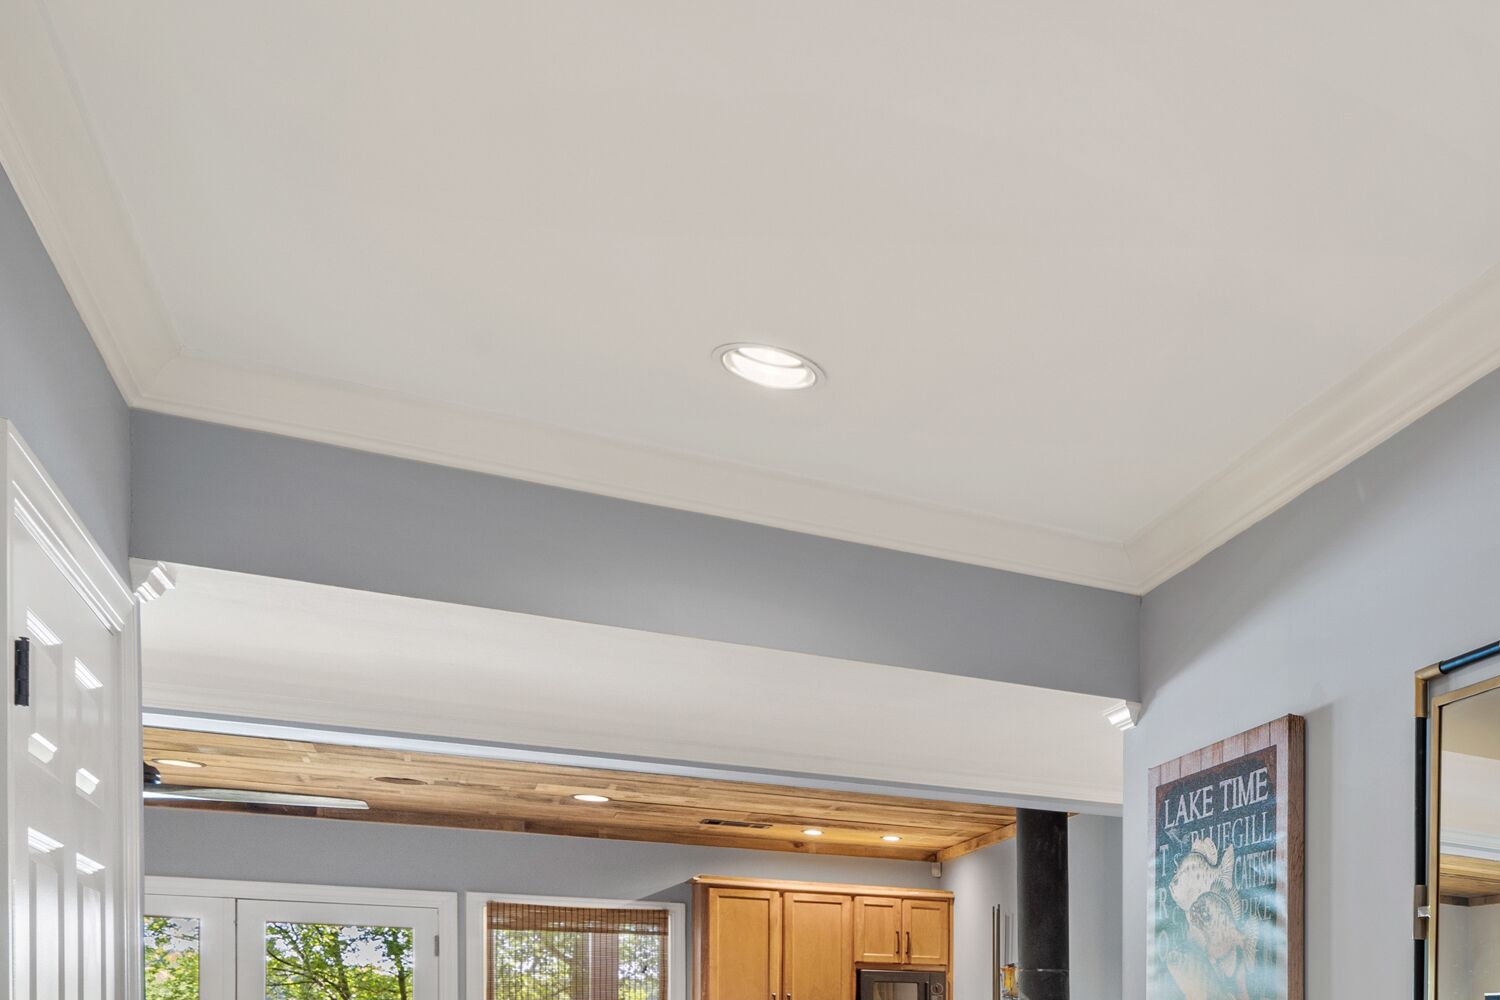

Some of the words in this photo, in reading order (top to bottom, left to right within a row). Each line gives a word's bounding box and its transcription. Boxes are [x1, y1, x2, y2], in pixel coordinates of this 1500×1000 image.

[1164, 785, 1214, 829] LAKE
[1220, 767, 1269, 812] TIME
[1234, 849, 1274, 889] CATFISH
